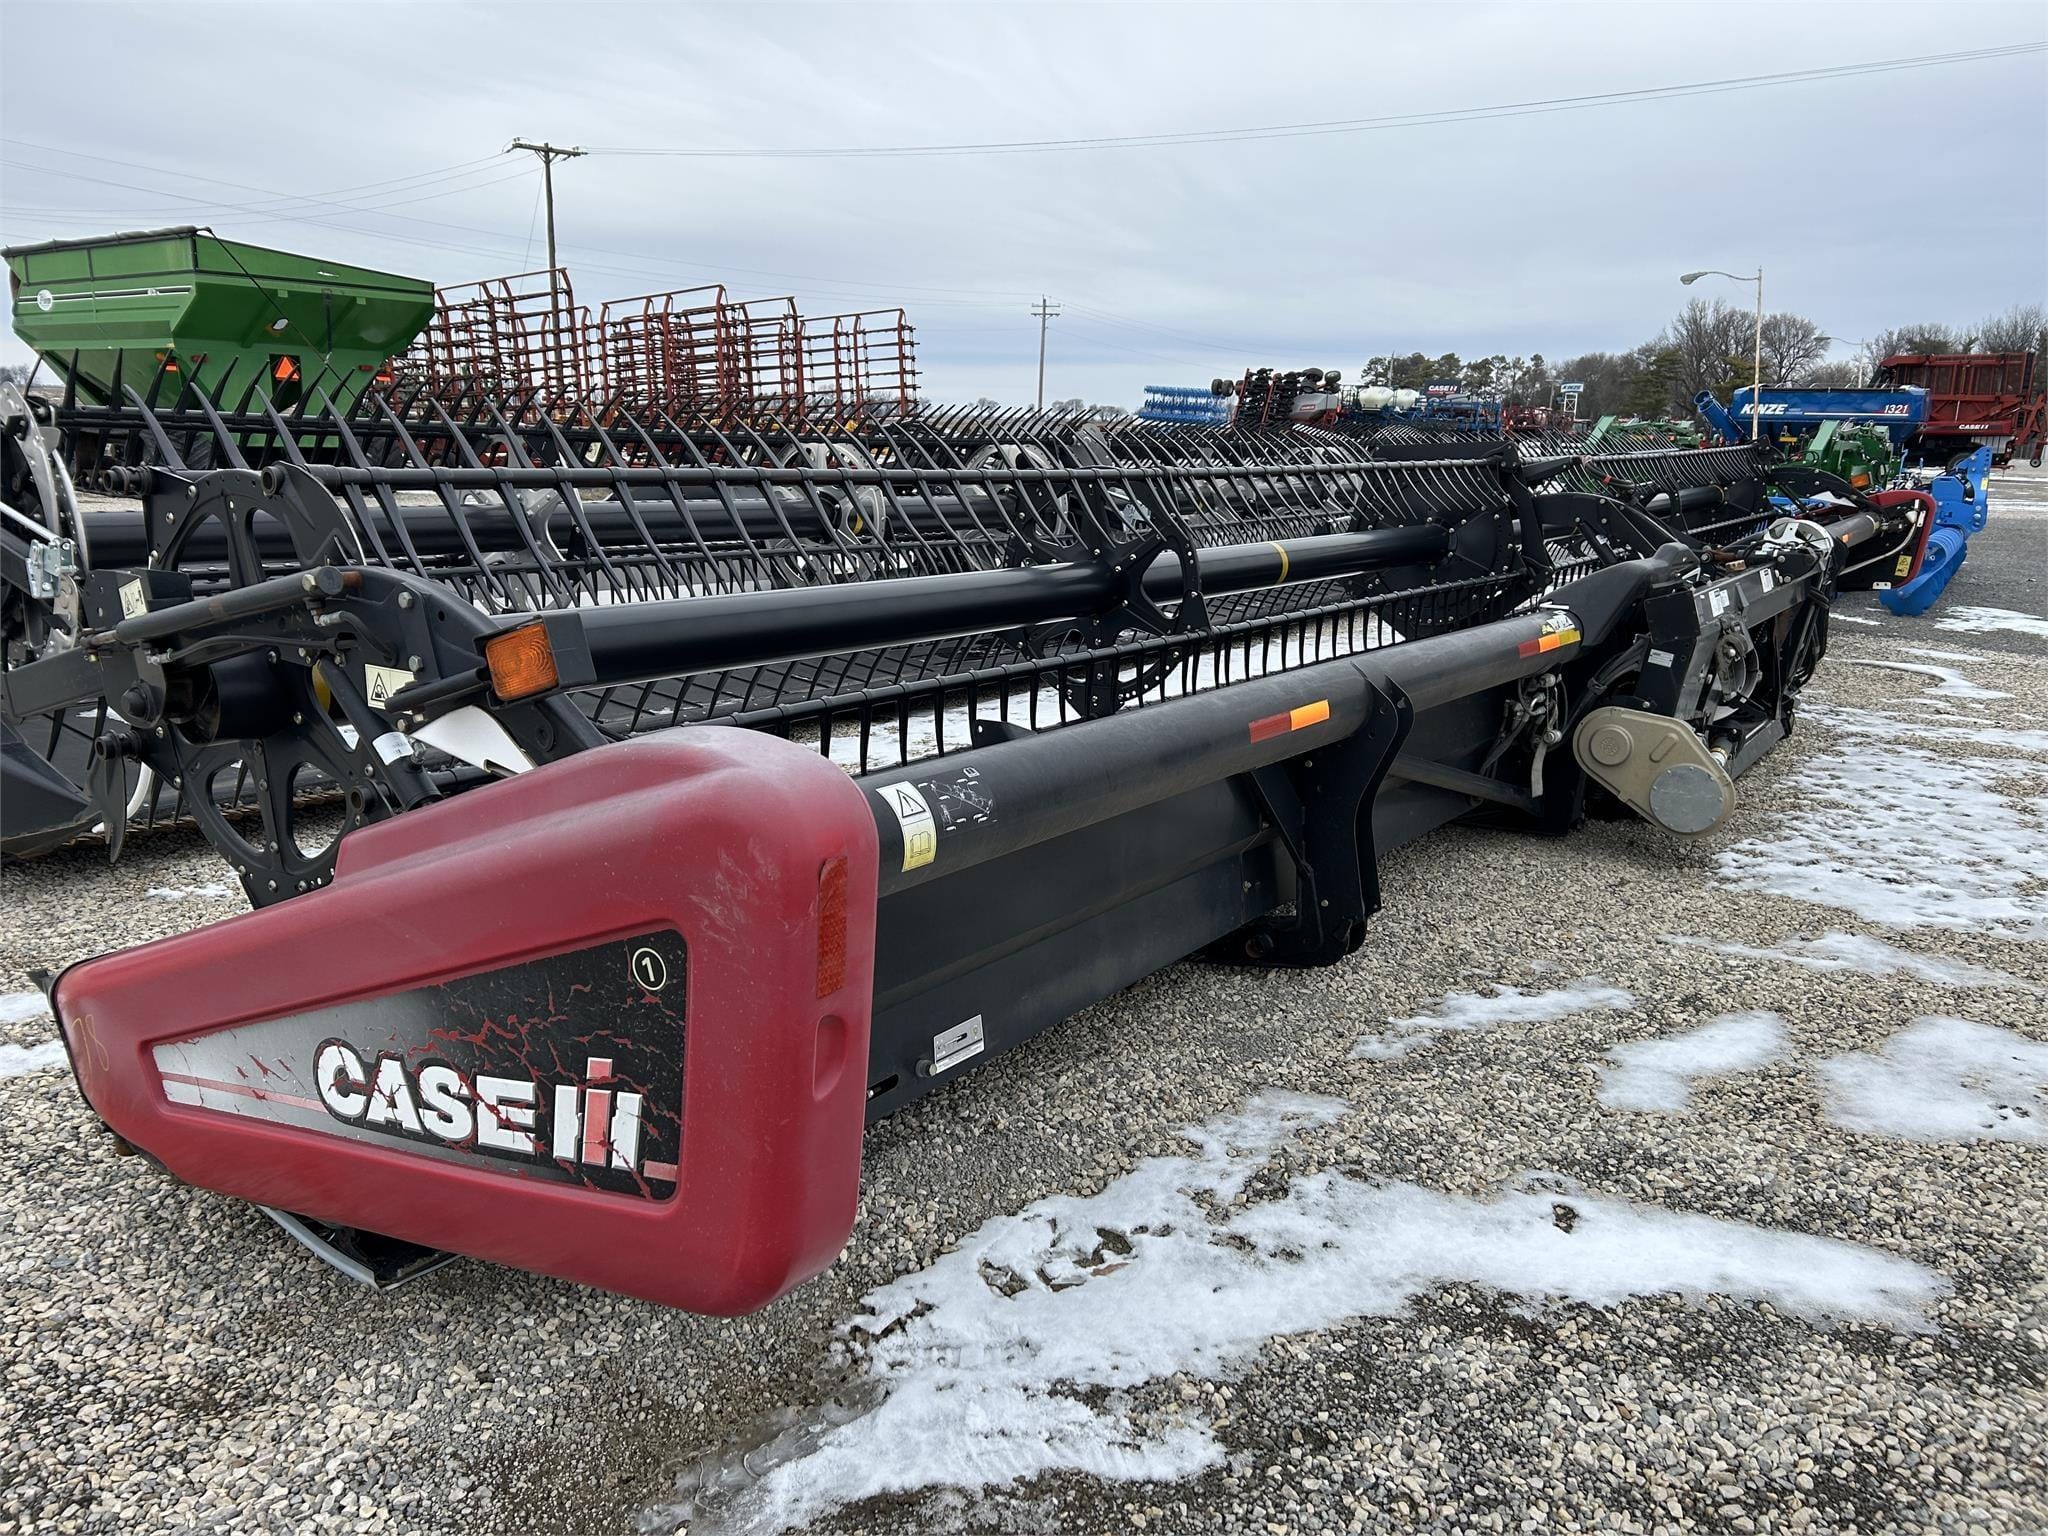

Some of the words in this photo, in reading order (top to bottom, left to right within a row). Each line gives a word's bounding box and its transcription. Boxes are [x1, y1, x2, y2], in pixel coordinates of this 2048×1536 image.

[1740, 403, 1788, 415] KNZE
[1884, 404, 1909, 414] 1321
[641, 956, 655, 982] 1
[316, 1044, 537, 1154] CASE
